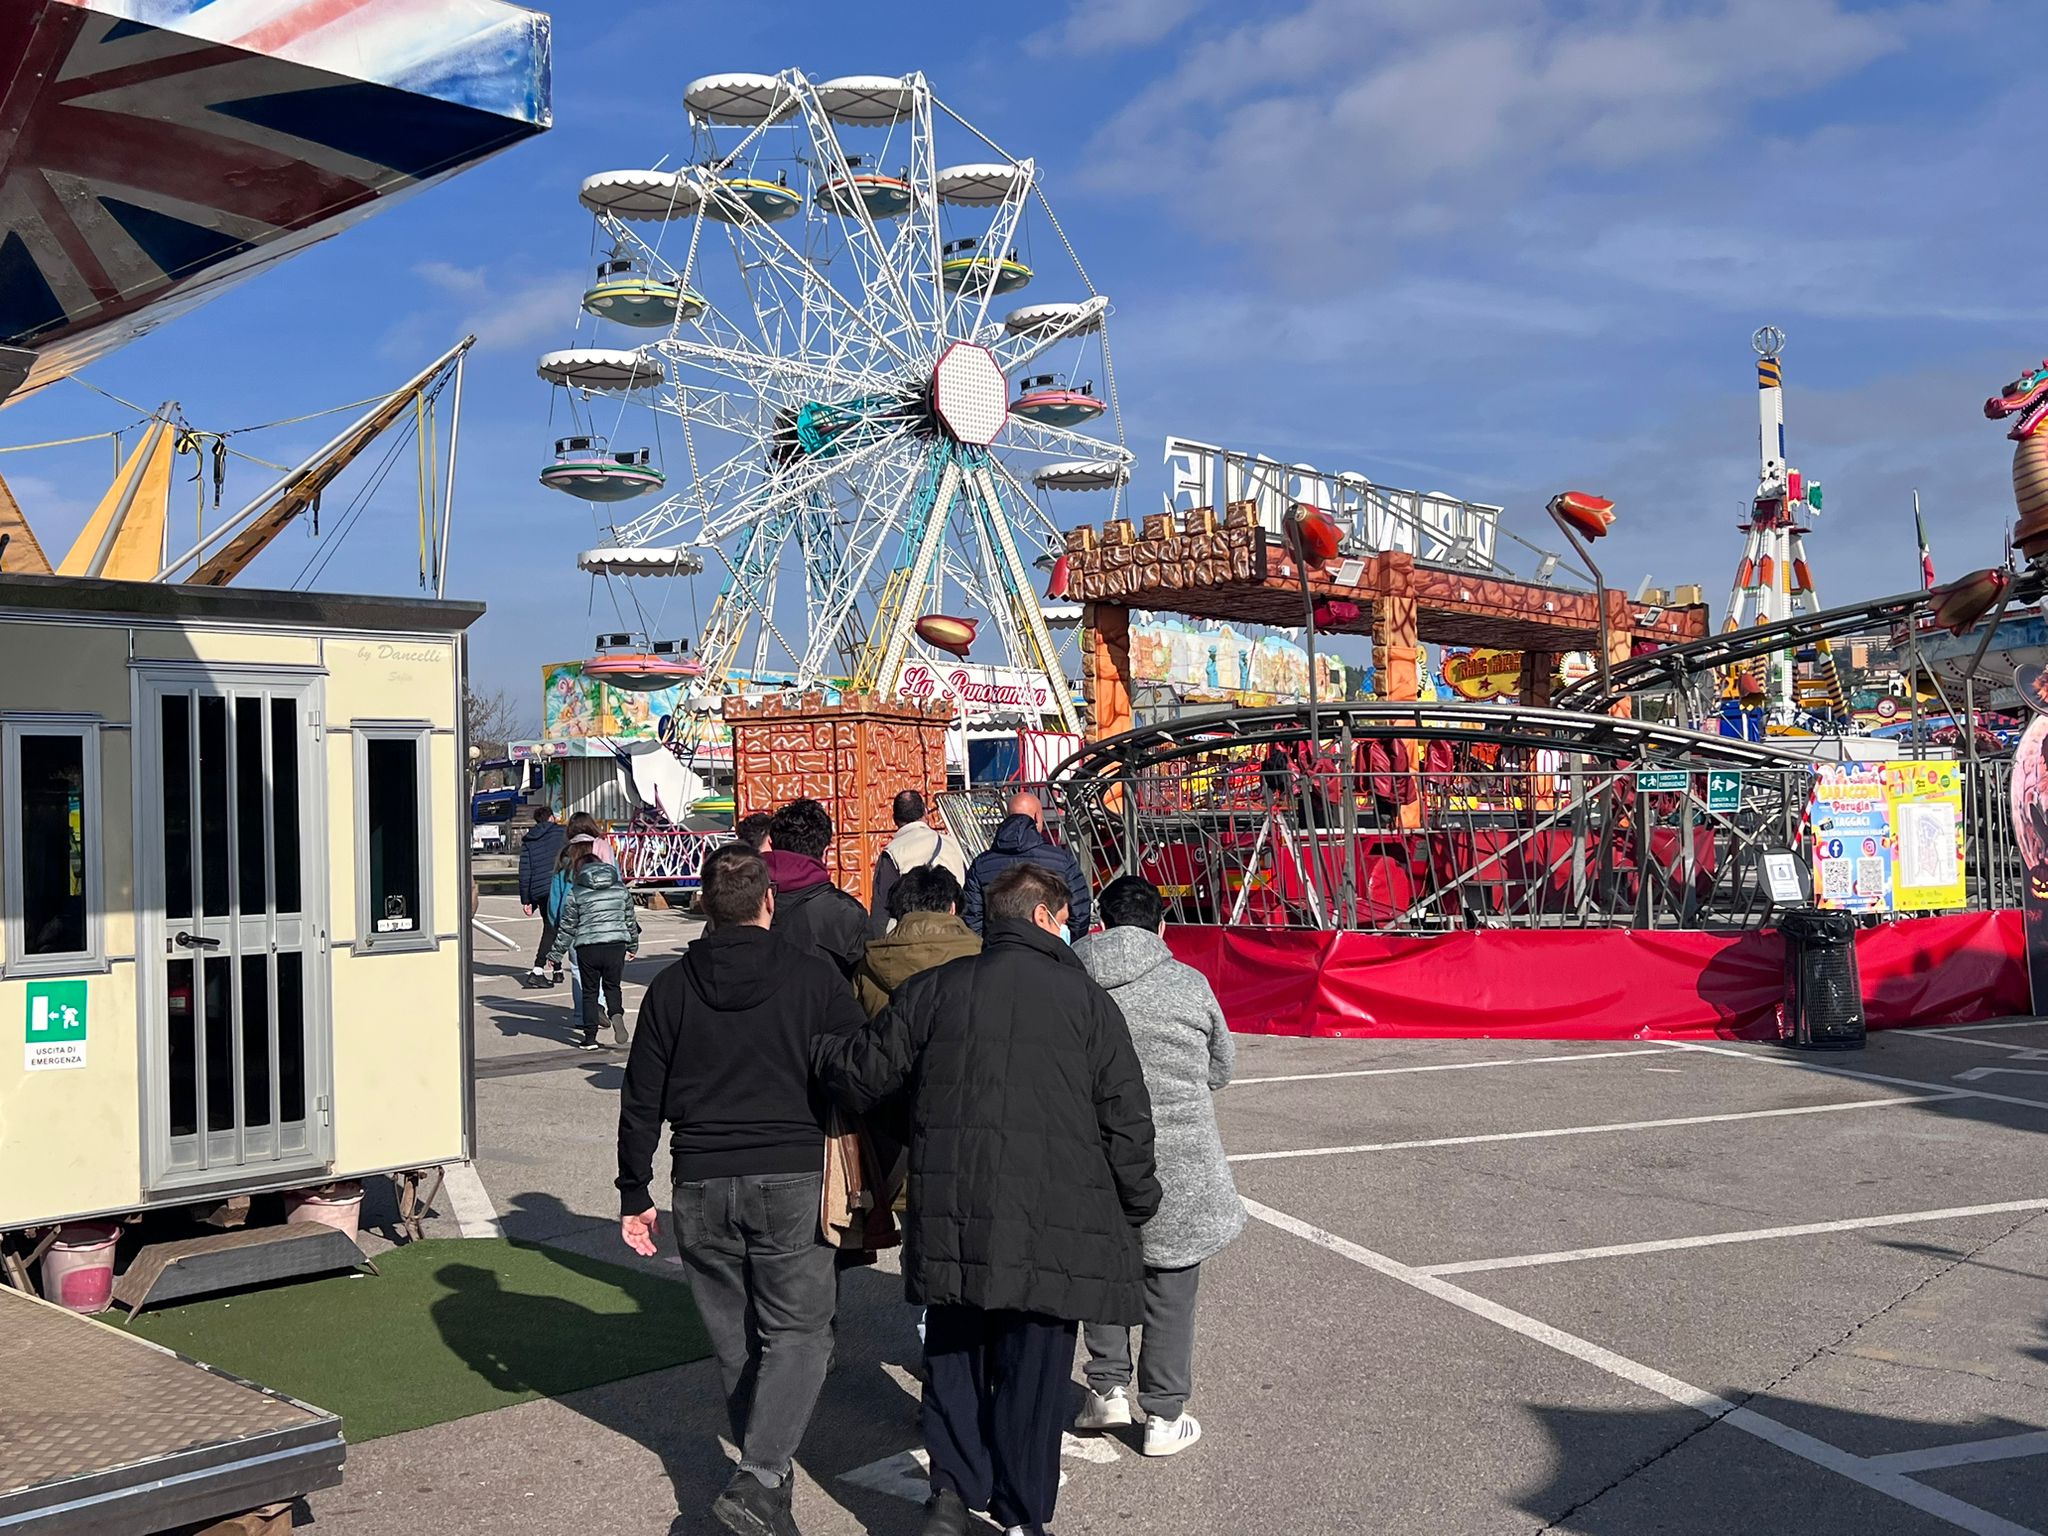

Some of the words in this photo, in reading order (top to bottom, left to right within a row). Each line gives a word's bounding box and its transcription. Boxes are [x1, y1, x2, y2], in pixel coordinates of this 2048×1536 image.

[357, 646, 371, 661] by
[378, 644, 441, 662] Dancelli
[899, 666, 935, 698] La
[1832, 801, 1870, 813] Perugia
[1834, 815, 1870, 827] TAGGACI
[36, 1047, 65, 1055] USCITA
[67, 1046, 76, 1054] DI
[31, 1056, 82, 1066] EMERGENZA
